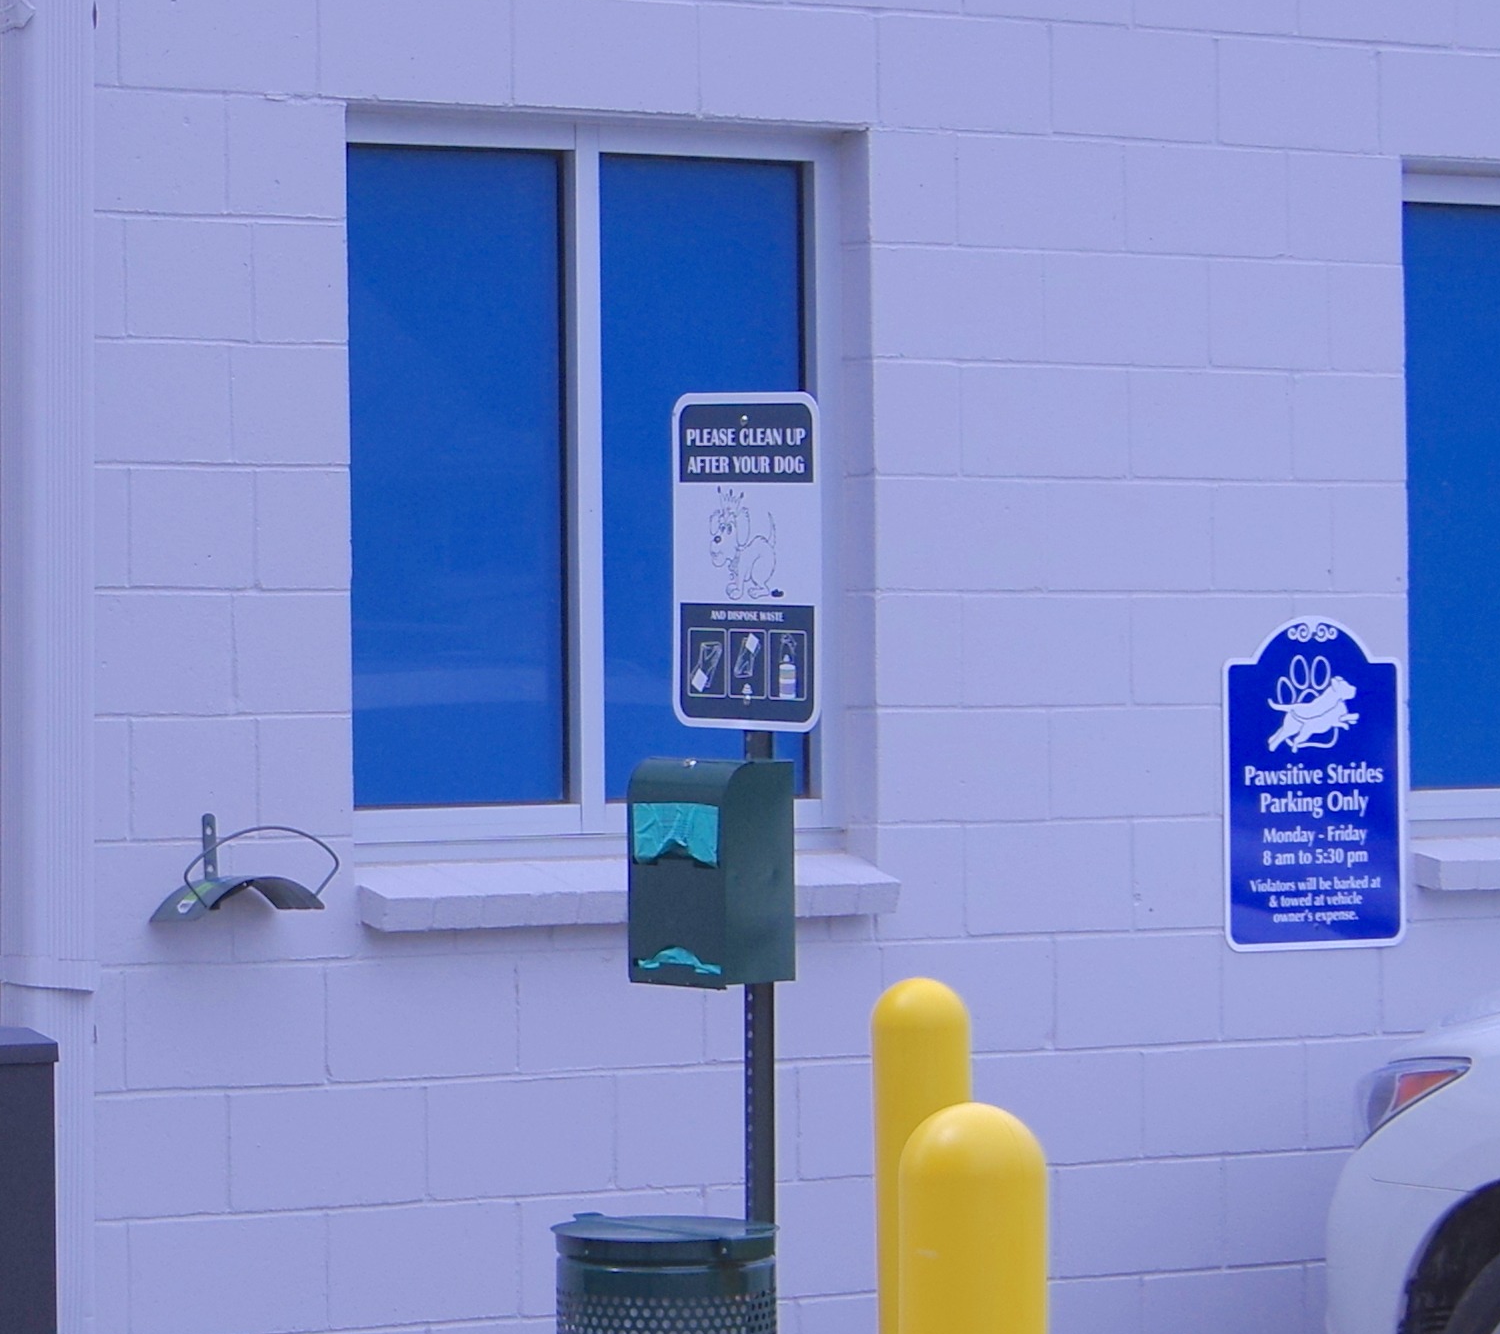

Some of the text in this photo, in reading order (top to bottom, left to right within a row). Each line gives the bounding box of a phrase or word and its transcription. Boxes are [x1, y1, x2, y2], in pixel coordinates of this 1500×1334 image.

[686, 428, 806, 446] PLEASE CLEAN UP
[687, 455, 805, 474] AFTER YOUR DOG
[710, 610, 784, 622] AND DISPOSE WASTE
[1245, 761, 1384, 786] Pawsitive Strides
[1260, 789, 1369, 819] Parking Only
[1263, 825, 1315, 847] Monday
[1327, 824, 1368, 846] Friday
[1263, 848, 1368, 868] 8 am to 5:30 pm
[1249, 875, 1381, 892] Violators will be barked at
[1268, 891, 1363, 908] & towed at vehicle
[1273, 909, 1359, 925] owner's expense.
